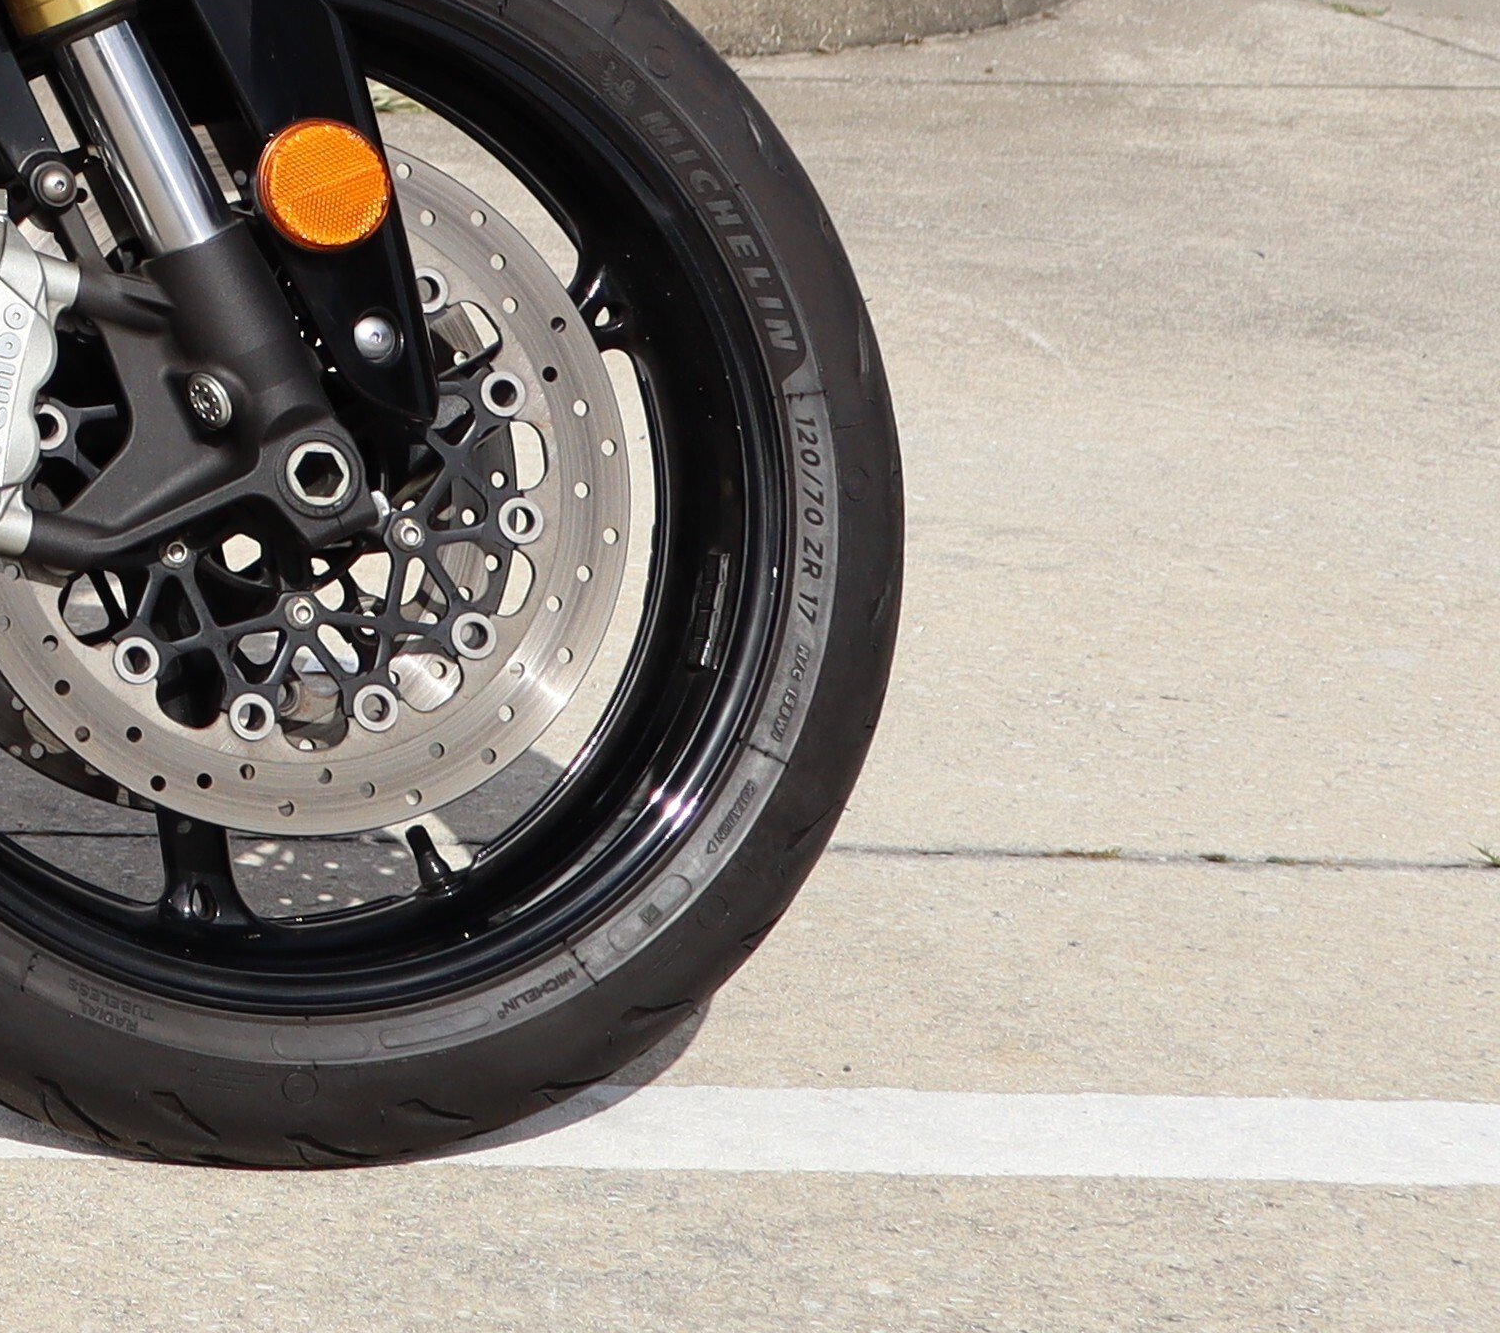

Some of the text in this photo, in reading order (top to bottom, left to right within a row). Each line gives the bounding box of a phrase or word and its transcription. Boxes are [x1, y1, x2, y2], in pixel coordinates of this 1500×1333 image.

[634, 100, 800, 359] MICHELIN
[792, 413, 825, 626] 120/70 ZR 17
